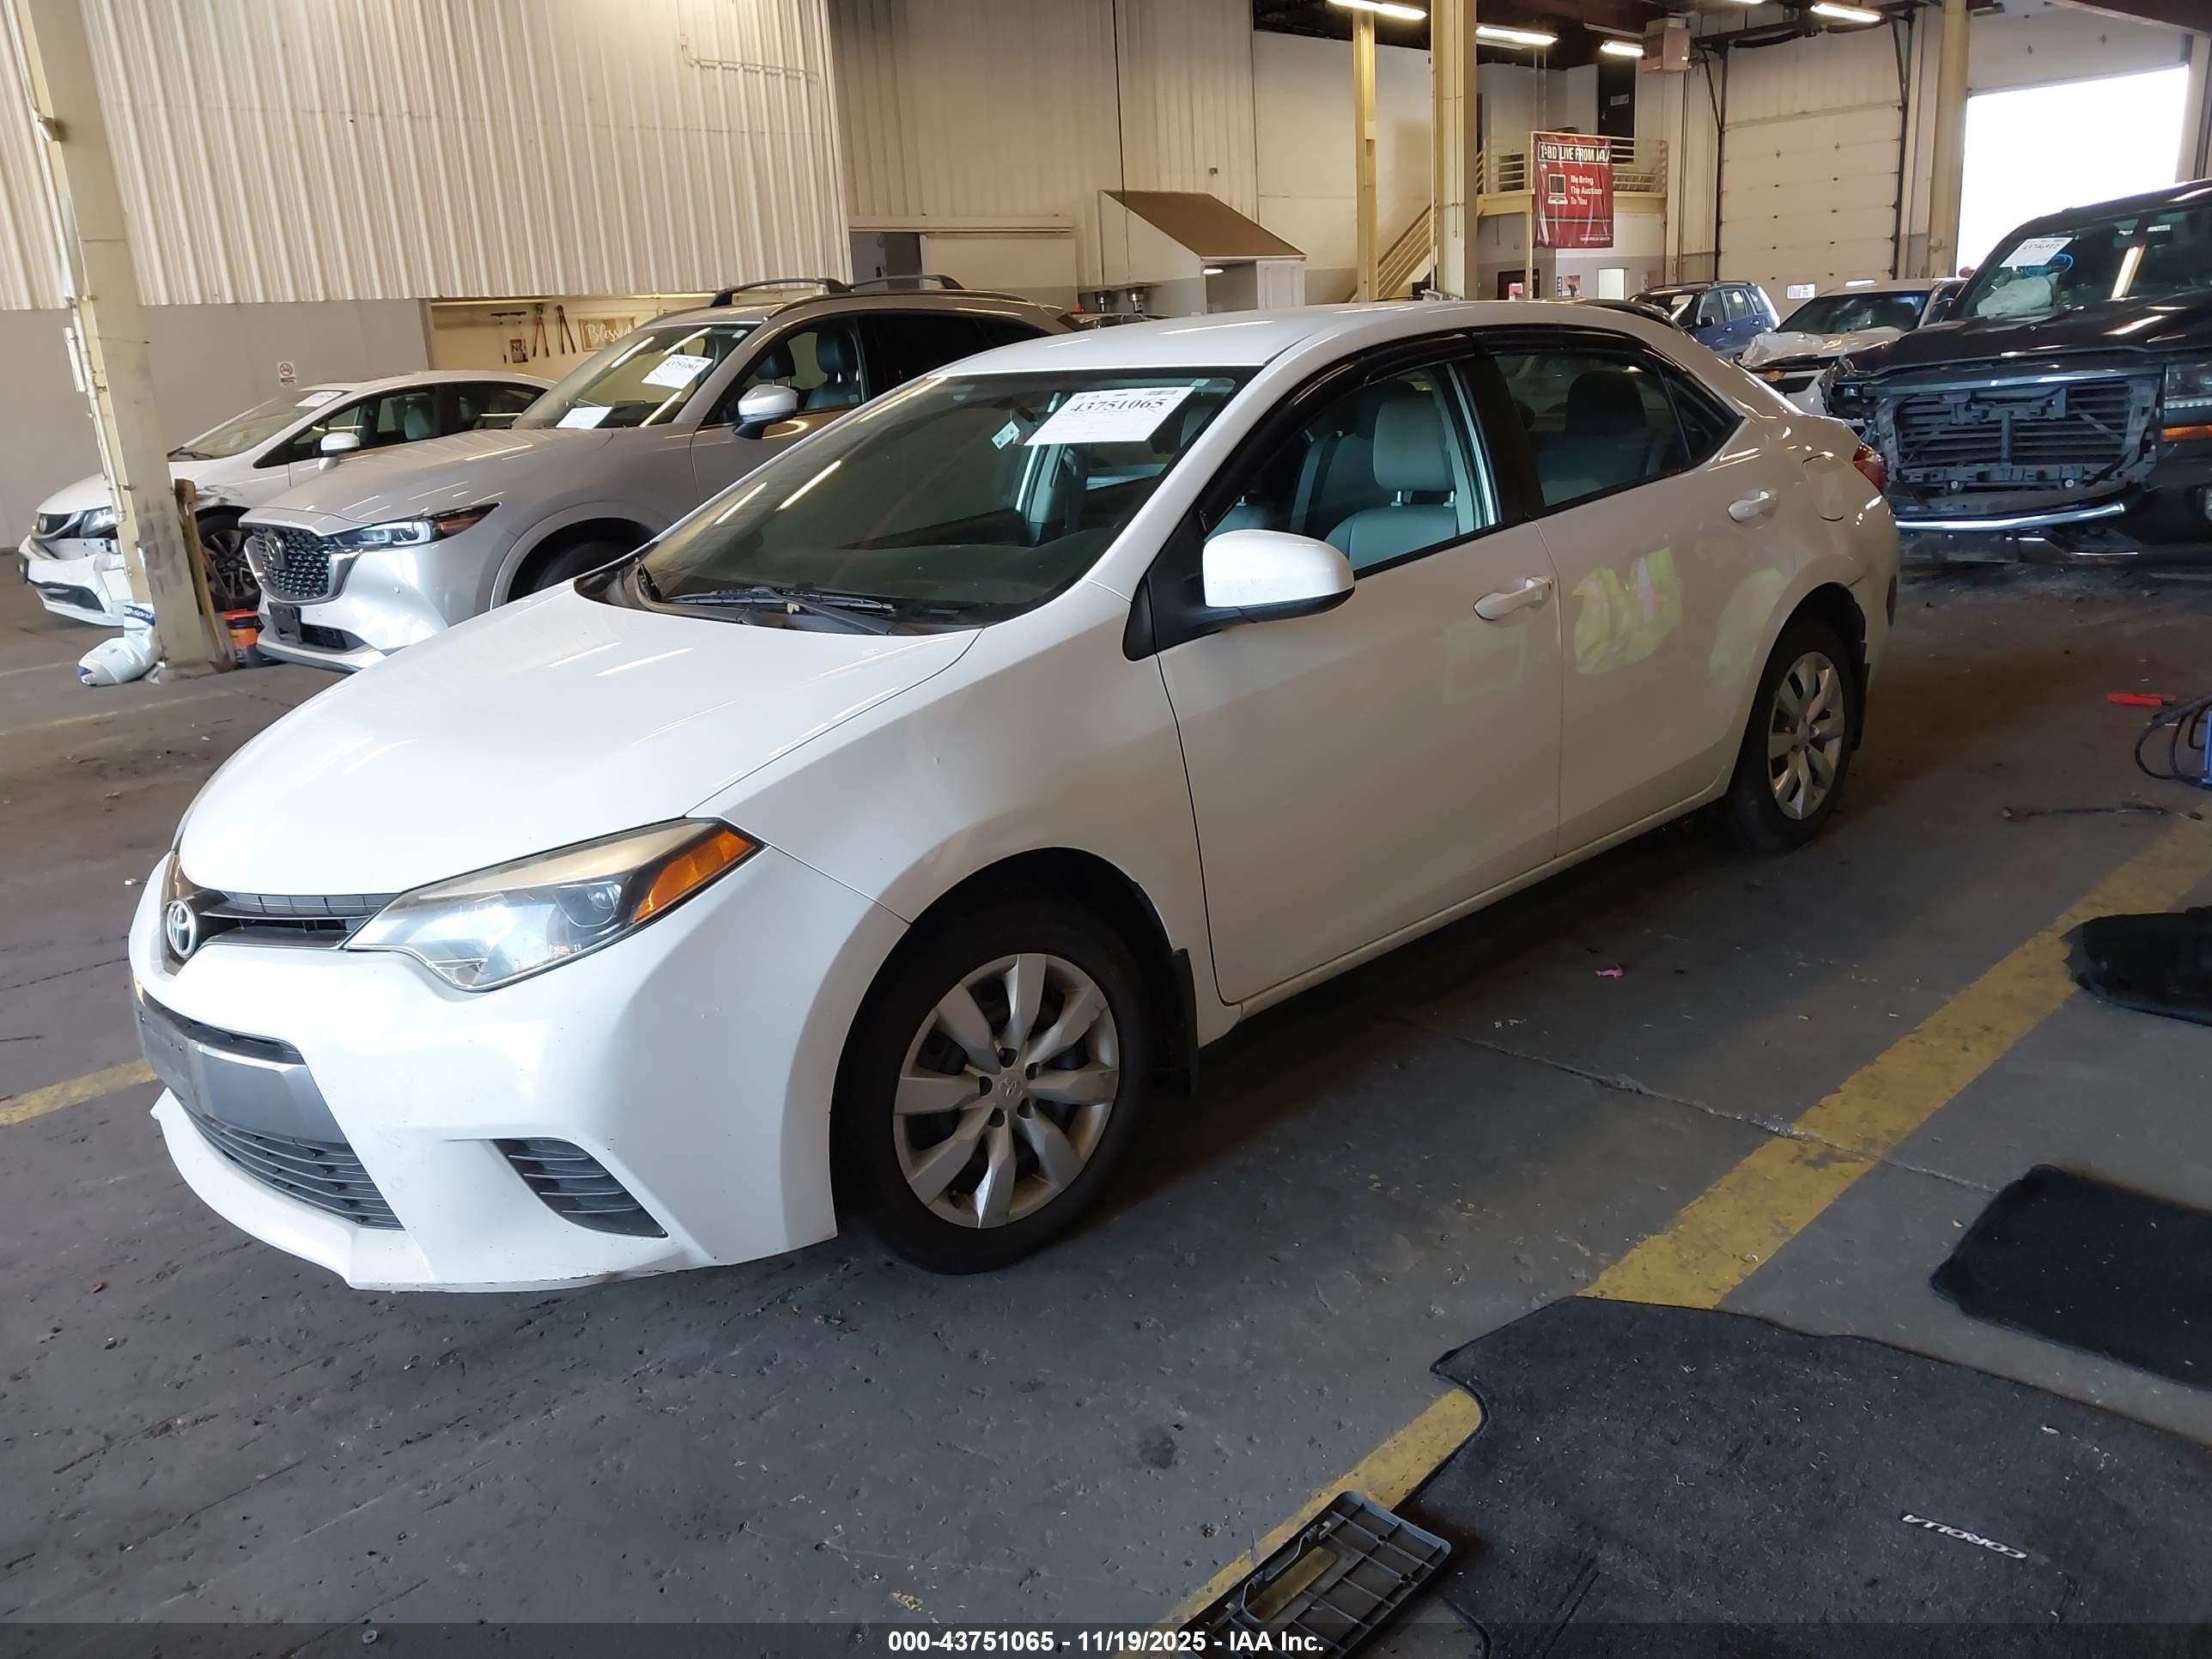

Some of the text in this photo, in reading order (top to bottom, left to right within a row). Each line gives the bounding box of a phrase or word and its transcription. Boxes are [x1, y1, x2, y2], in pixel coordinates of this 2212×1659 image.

[1559, 146, 1574, 161] LIVE
[1575, 147, 1595, 161] FROM
[1579, 175, 1595, 186] Bring
[1570, 185, 1580, 195] The
[1570, 197, 1588, 205] To You
[1070, 398, 1168, 413] 43751065
[1902, 1514, 2027, 1559] COROLLA
